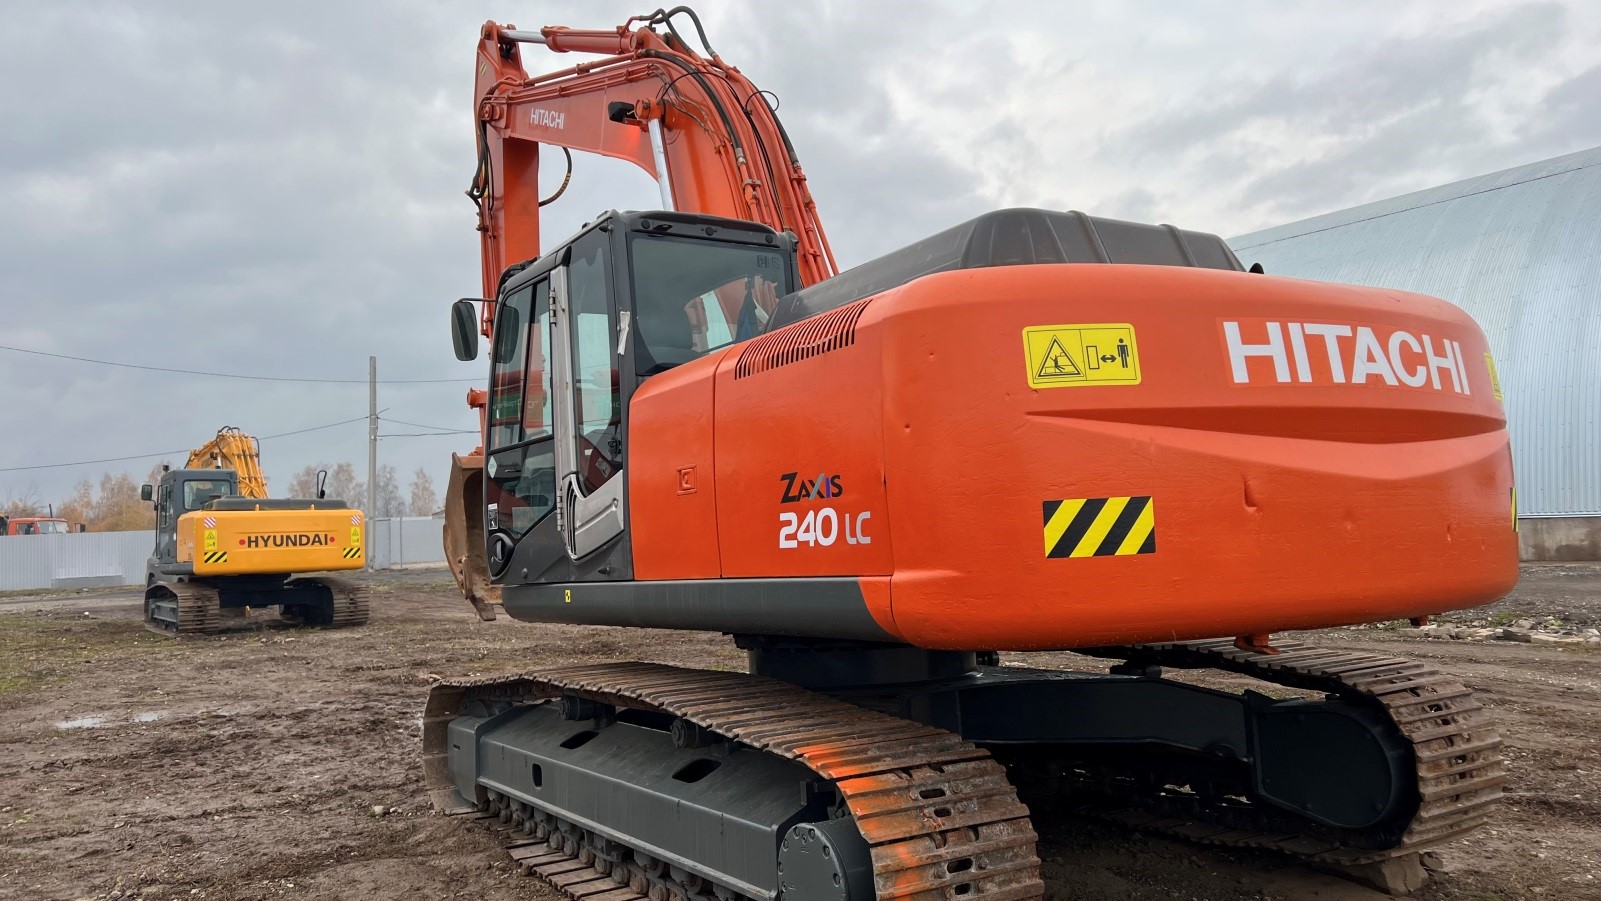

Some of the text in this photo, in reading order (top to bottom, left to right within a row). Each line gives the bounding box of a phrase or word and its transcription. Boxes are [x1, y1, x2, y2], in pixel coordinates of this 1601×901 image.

[530, 107, 565, 130] HITACHI
[1222, 321, 1471, 396] HITACHI
[247, 533, 329, 548] HYUNDAI
[779, 507, 872, 549] 240 LC
